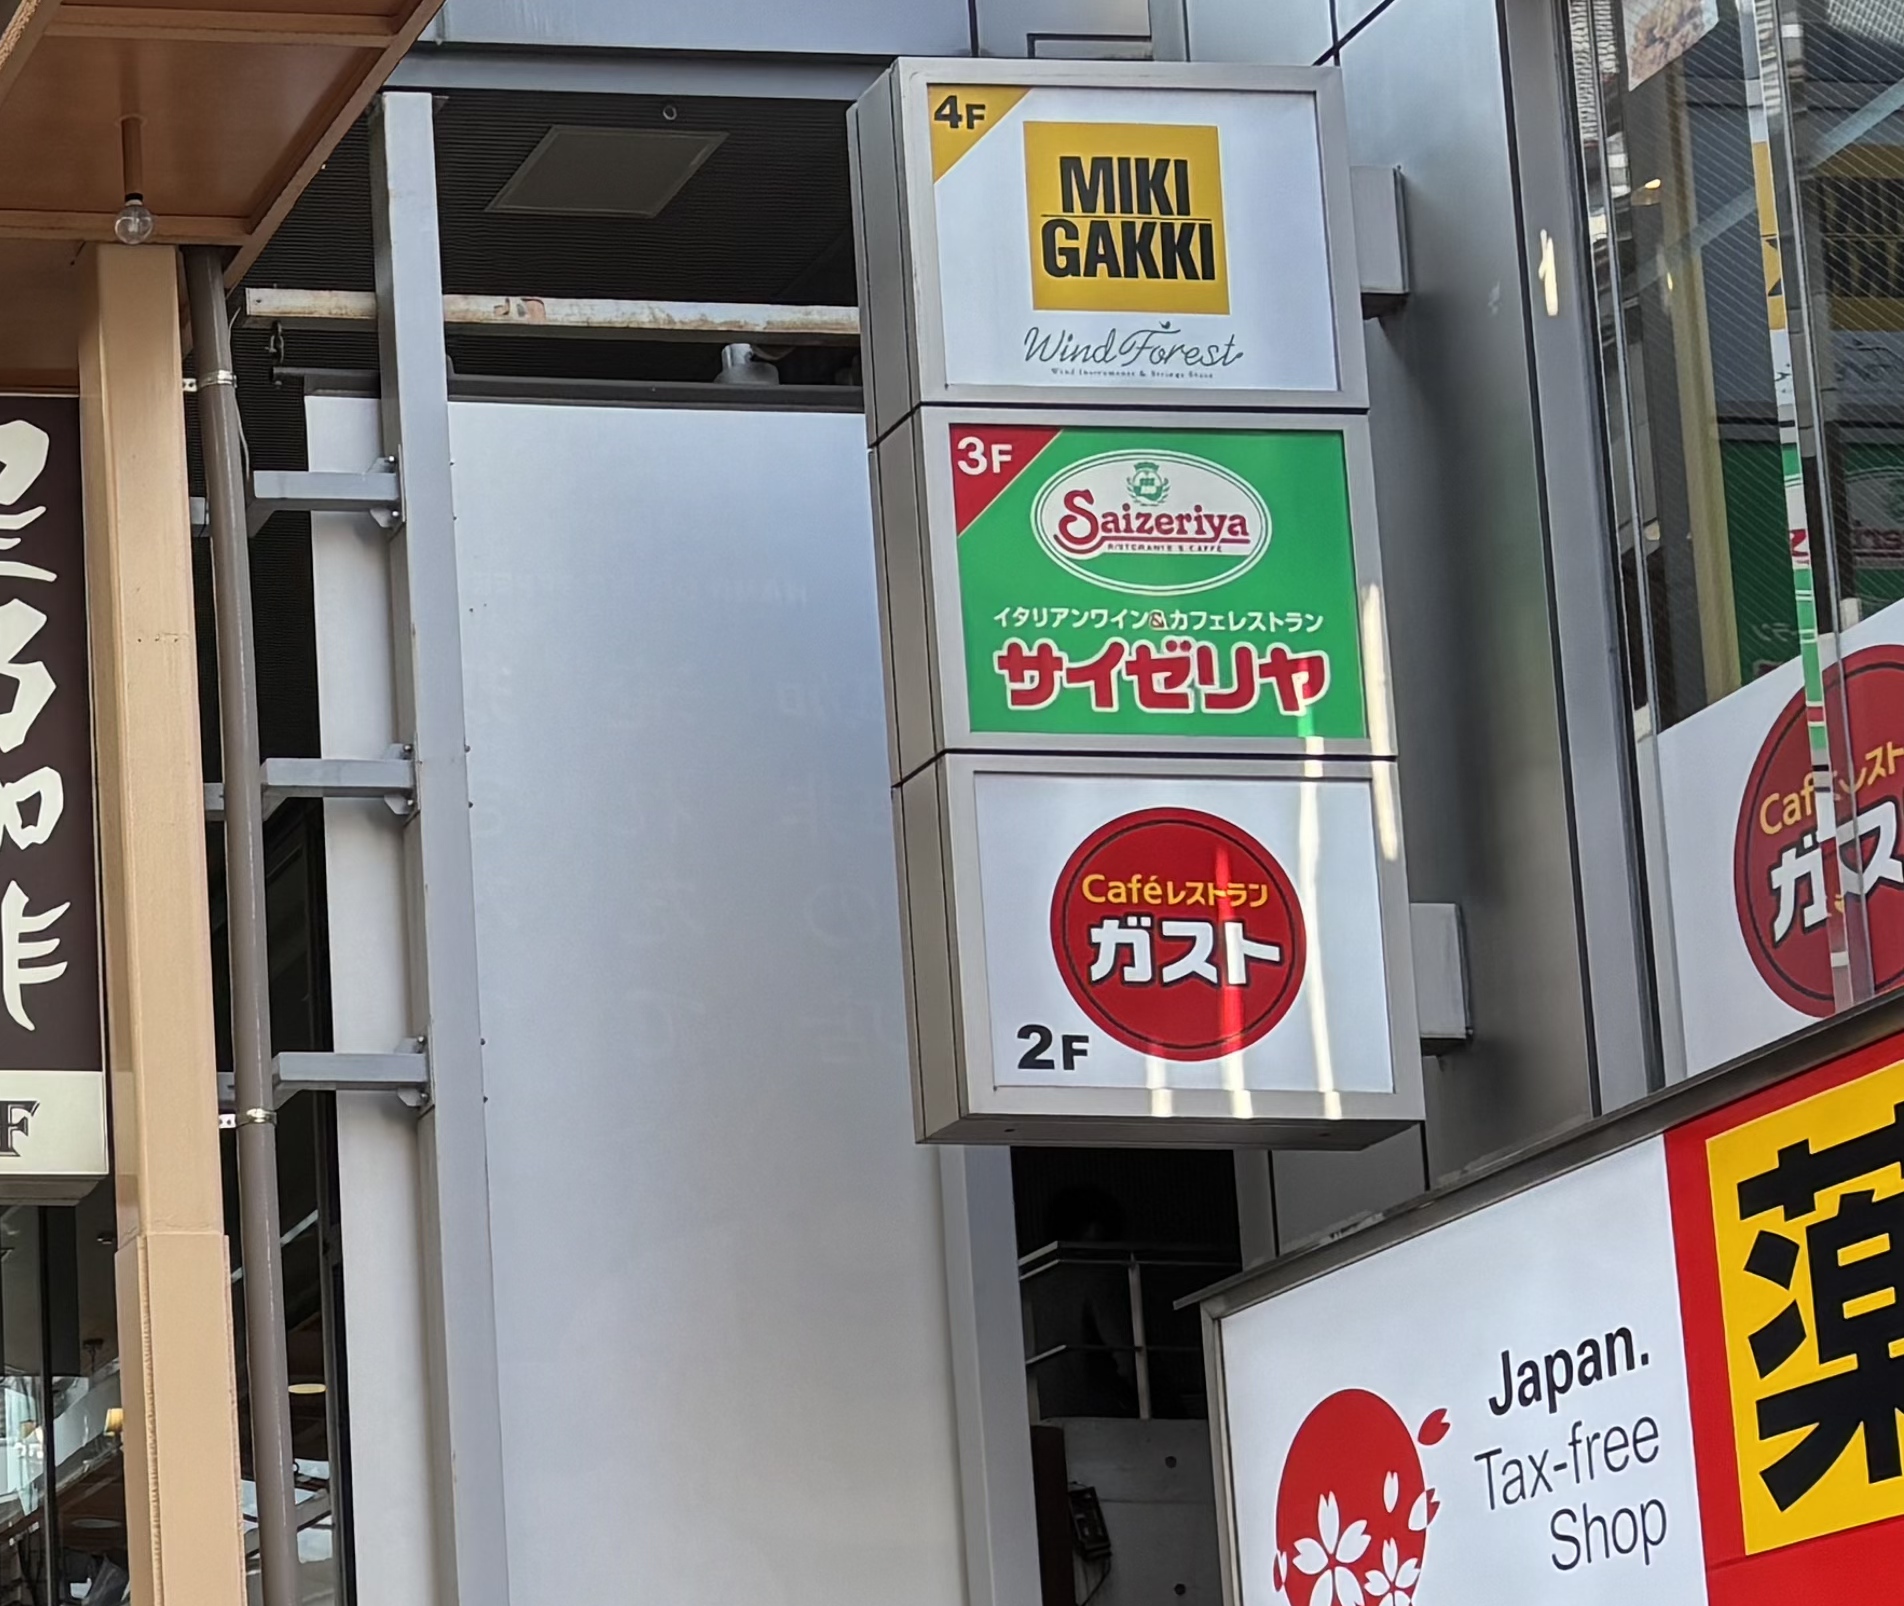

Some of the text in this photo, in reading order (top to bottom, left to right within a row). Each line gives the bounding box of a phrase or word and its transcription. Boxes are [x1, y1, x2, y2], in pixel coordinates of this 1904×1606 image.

[934, 93, 987, 131] 4F
[1058, 155, 1191, 217] MIKI
[1040, 217, 1215, 282] GAKKI
[1024, 326, 1244, 367] Wind Forest
[956, 437, 1013, 476] 3F
[1054, 488, 1250, 553] Saizeriya
[993, 637, 1332, 716] サイゼリヤ
[1087, 917, 1287, 987] ガスト
[1016, 1023, 1090, 1071] 2F
[1488, 1325, 1651, 1417] Japan.
[1473, 1410, 1662, 1512] Tax-free
[1549, 1494, 1668, 1573] Shop
